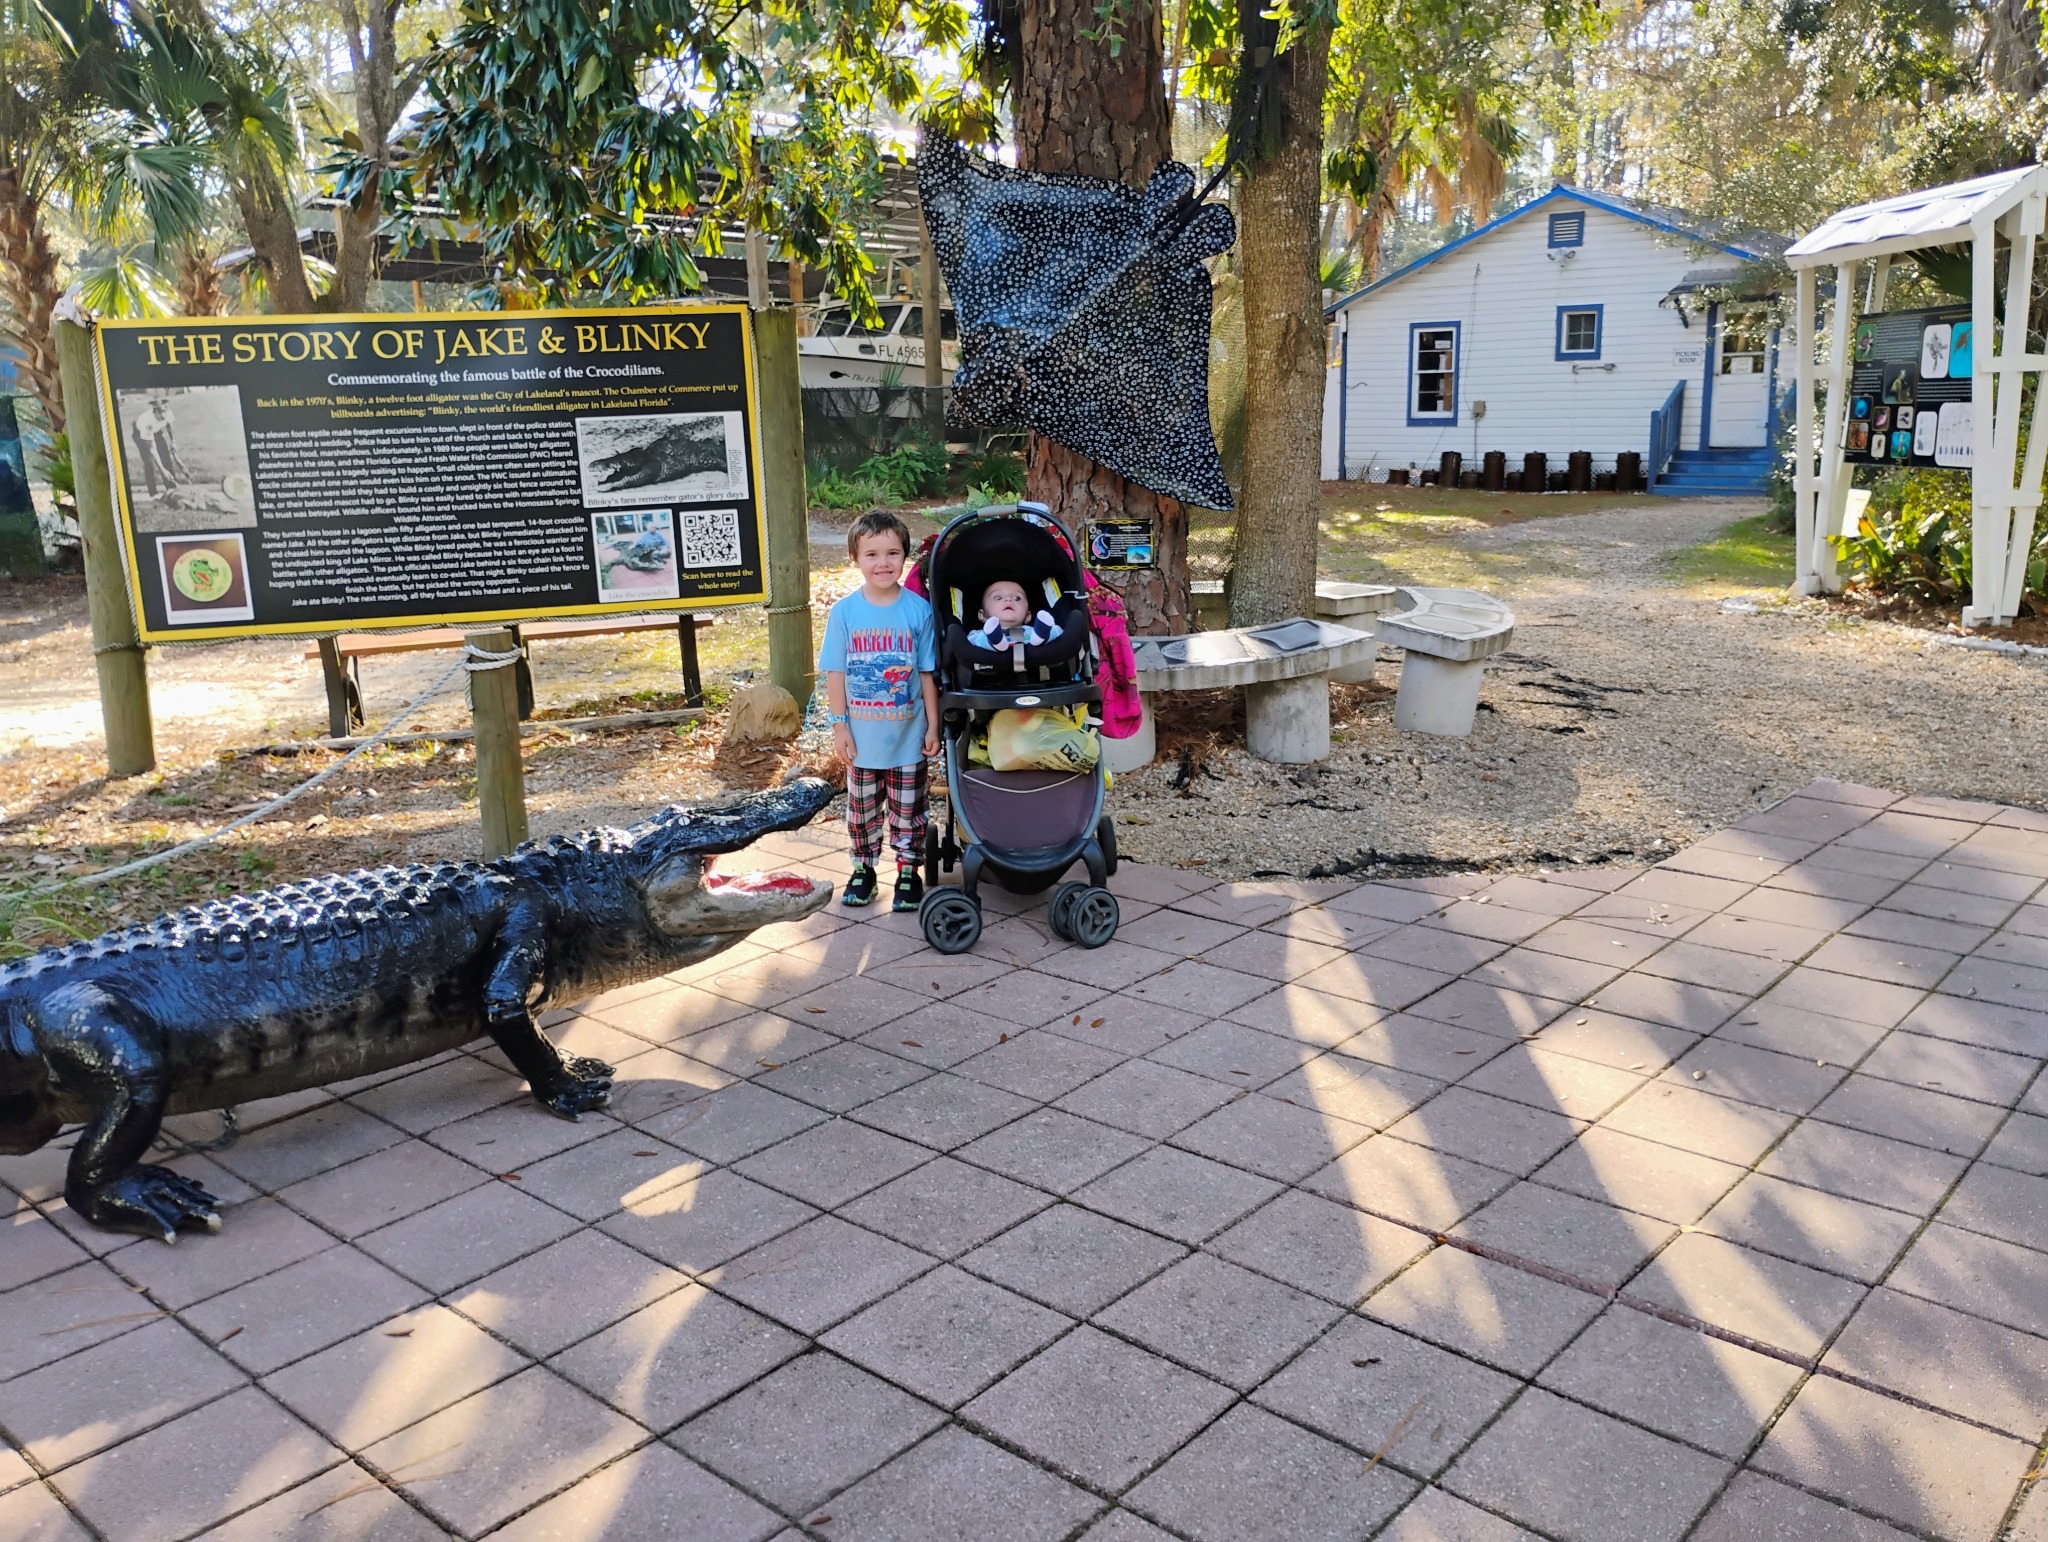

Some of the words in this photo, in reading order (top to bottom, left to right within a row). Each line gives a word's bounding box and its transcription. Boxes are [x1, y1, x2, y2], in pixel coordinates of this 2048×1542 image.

[137, 334, 224, 365] THE
[232, 330, 361, 363] STORY
[372, 329, 424, 358] OF
[433, 327, 528, 364] JAKE
[538, 326, 566, 354] &
[574, 322, 710, 352] BLINKY
[879, 345, 894, 358] FL
[897, 346, 925, 359] 4565
[327, 371, 438, 386] Commemorating
[440, 370, 460, 382] the
[462, 369, 509, 382] famous
[511, 367, 546, 380] battle
[548, 366, 561, 379] of
[564, 366, 583, 378] the
[586, 364, 664, 377] Crocodilians.
[256, 398, 278, 407] Back
[279, 398, 289, 406] in
[290, 397, 304, 406] the
[305, 396, 335, 406] 1970's,
[335, 395, 367, 406] Blinky,
[375, 394, 405, 403] twelve
[406, 394, 424, 402] foot
[425, 393, 460, 404] alligator
[480, 391, 494, 400] the
[495, 391, 513, 401] City
[514, 390, 524, 399] of
[525, 389, 570, 398] Lakeland's
[571, 389, 602, 397] mascot.
[603, 387, 619, 395] The
[620, 386, 657, 395] Chamber
[658, 385, 667, 393] of
[668, 385, 711, 393] Commerce
[712, 384, 726, 393] put
[727, 384, 738, 392] up
[330, 408, 374, 418] billboards
[375, 407, 426, 417] advertising:
[464, 405, 478, 414] the
[479, 404, 511, 413] world's
[512, 403, 554, 412] friendliest
[555, 402, 589, 412] alligator
[591, 401, 599, 409] in
[600, 399, 638, 408] Lakeland
[251, 431, 265, 439] The
[266, 431, 290, 439] eleven
[290, 430, 306, 438] foot
[307, 429, 330, 438] reptile
[331, 428, 352, 436] made
[353, 428, 384, 437] frequent
[459, 424, 476, 433] slept
[504, 422, 512, 430] of
[513, 422, 525, 430] the
[526, 422, 547, 430] police
[258, 461, 294, 469] elsewhere
[337, 458, 352, 466] and
[366, 457, 391, 465] Florida
[391, 456, 413, 464] Game
[414, 455, 428, 463] and
[471, 453, 485, 461] Fish
[486, 452, 529, 460] Commission
[551, 449, 573, 457] feared
[705, 492, 724, 500] glory
[726, 491, 744, 499] days
[263, 531, 281, 540] They
[281, 530, 306, 538] turned
[307, 529, 321, 537] him
[356, 527, 382, 536] lagoon
[399, 525, 413, 534] fifty
[415, 524, 446, 533] alligators
[476, 521, 490, 529] bad
[554, 516, 584, 524] crocodile
[393, 515, 420, 523] Wildlife
[268, 550, 283, 558] and
[284, 549, 309, 558] chased
[325, 547, 351, 556] around
[414, 544, 435, 552] Blinky
[436, 542, 455, 550] loved
[513, 538, 545, 546] ferocious
[700, 571, 716, 579] here
[725, 569, 741, 577] read
[426, 581, 449, 590] picked
[720, 581, 740, 589] story!
[847, 628, 914, 653] AMERICAN
[883, 665, 914, 684] 67
[849, 699, 914, 721] MUSCLE
